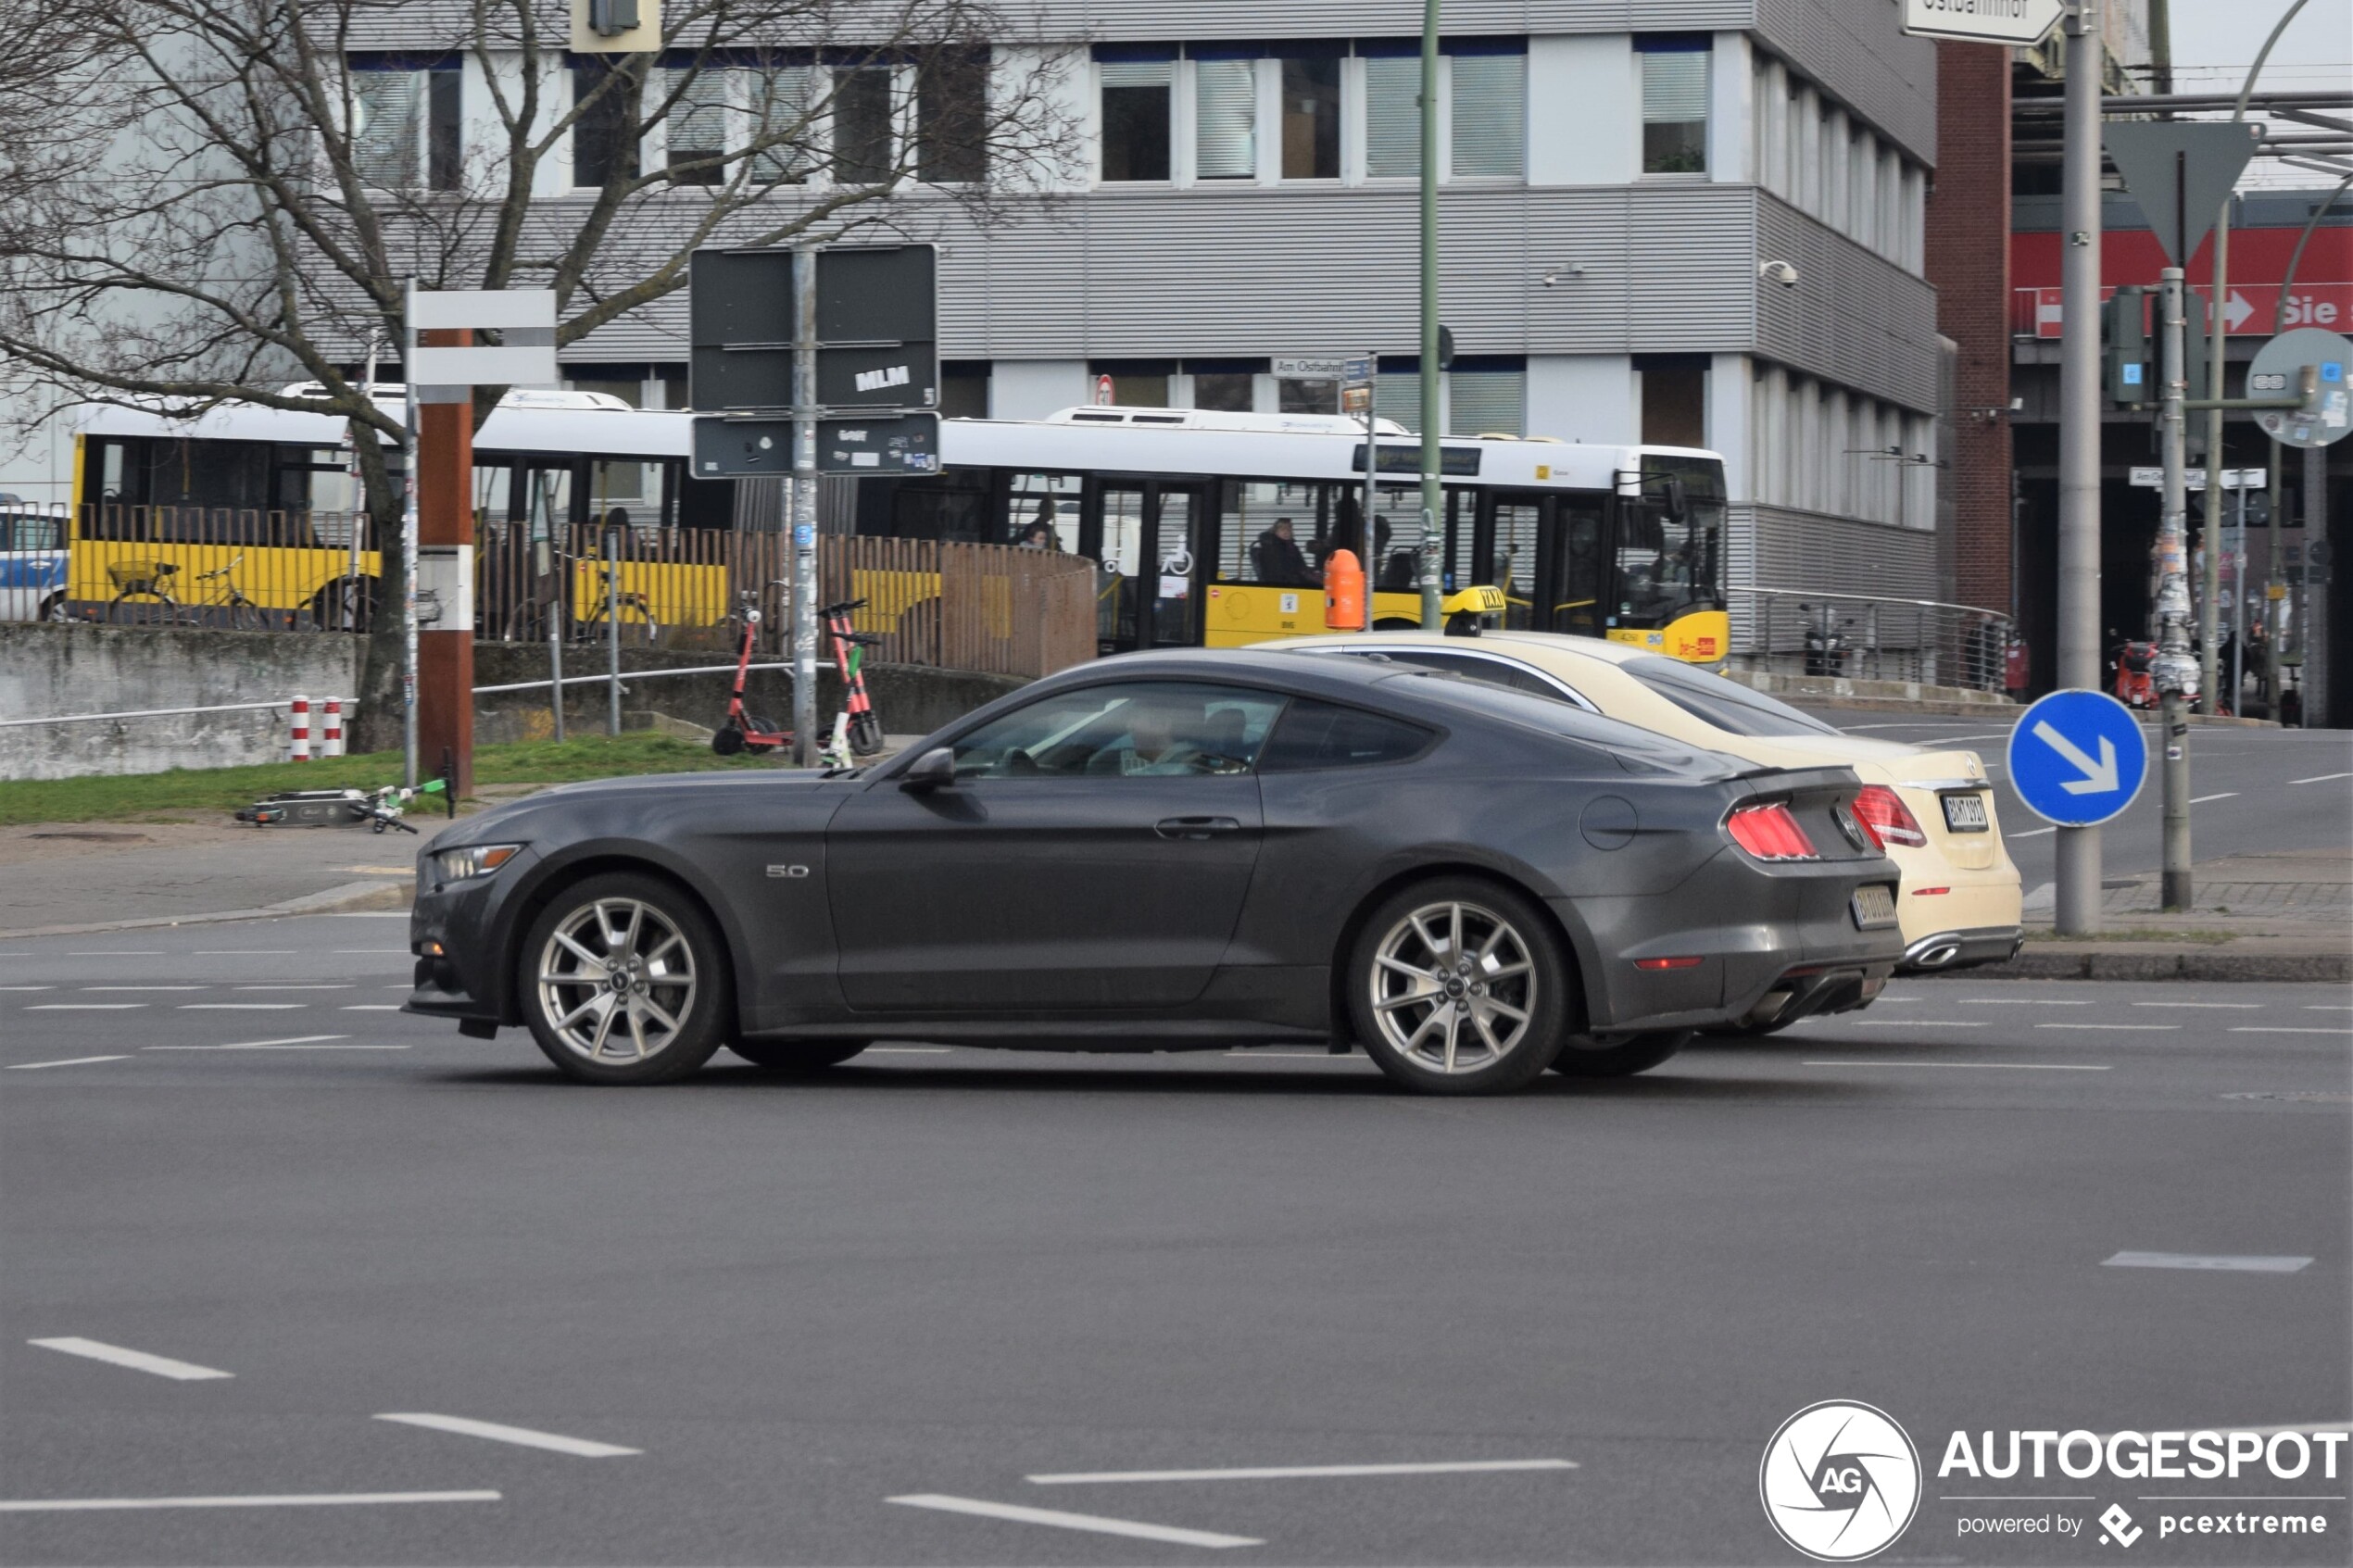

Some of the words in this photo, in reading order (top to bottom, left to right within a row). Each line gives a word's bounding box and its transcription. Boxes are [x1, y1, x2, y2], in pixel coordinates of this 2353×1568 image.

[2276, 296, 2338, 324] Sie
[1277, 361, 1294, 372] Am
[855, 366, 911, 392] MLM
[1480, 589, 1504, 608] TAXI
